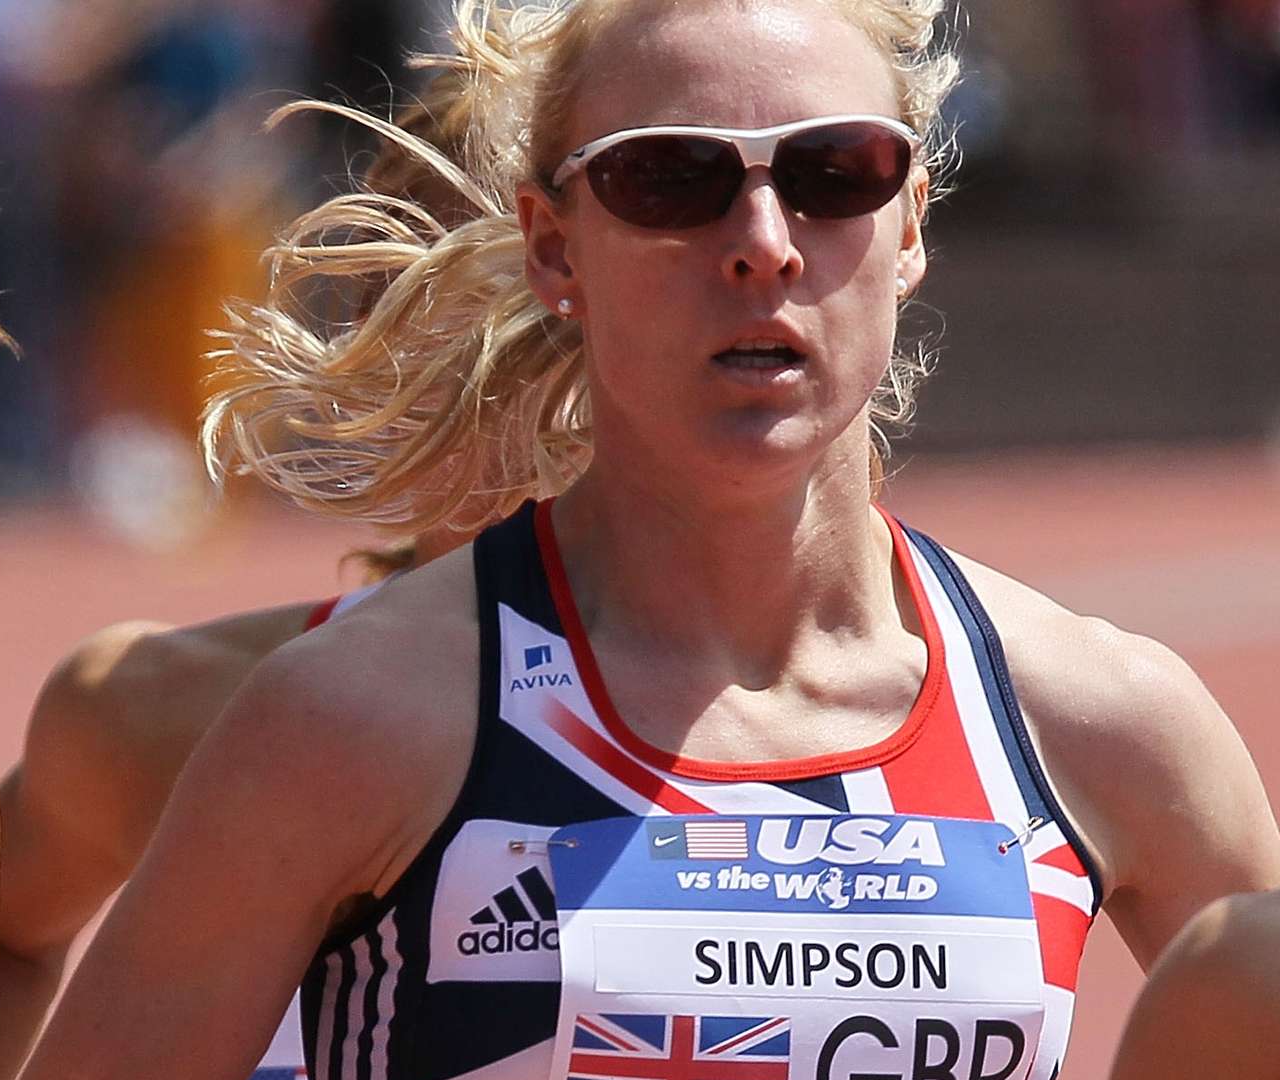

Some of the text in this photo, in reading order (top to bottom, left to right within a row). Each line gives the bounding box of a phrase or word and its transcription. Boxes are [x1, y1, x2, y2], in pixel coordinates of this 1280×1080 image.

[510, 673, 573, 693] AVIVA
[756, 818, 947, 867] USA
[677, 869, 713, 890] vs
[716, 865, 771, 890] the
[457, 920, 560, 956] adida
[694, 938, 948, 990] SIMPSON
